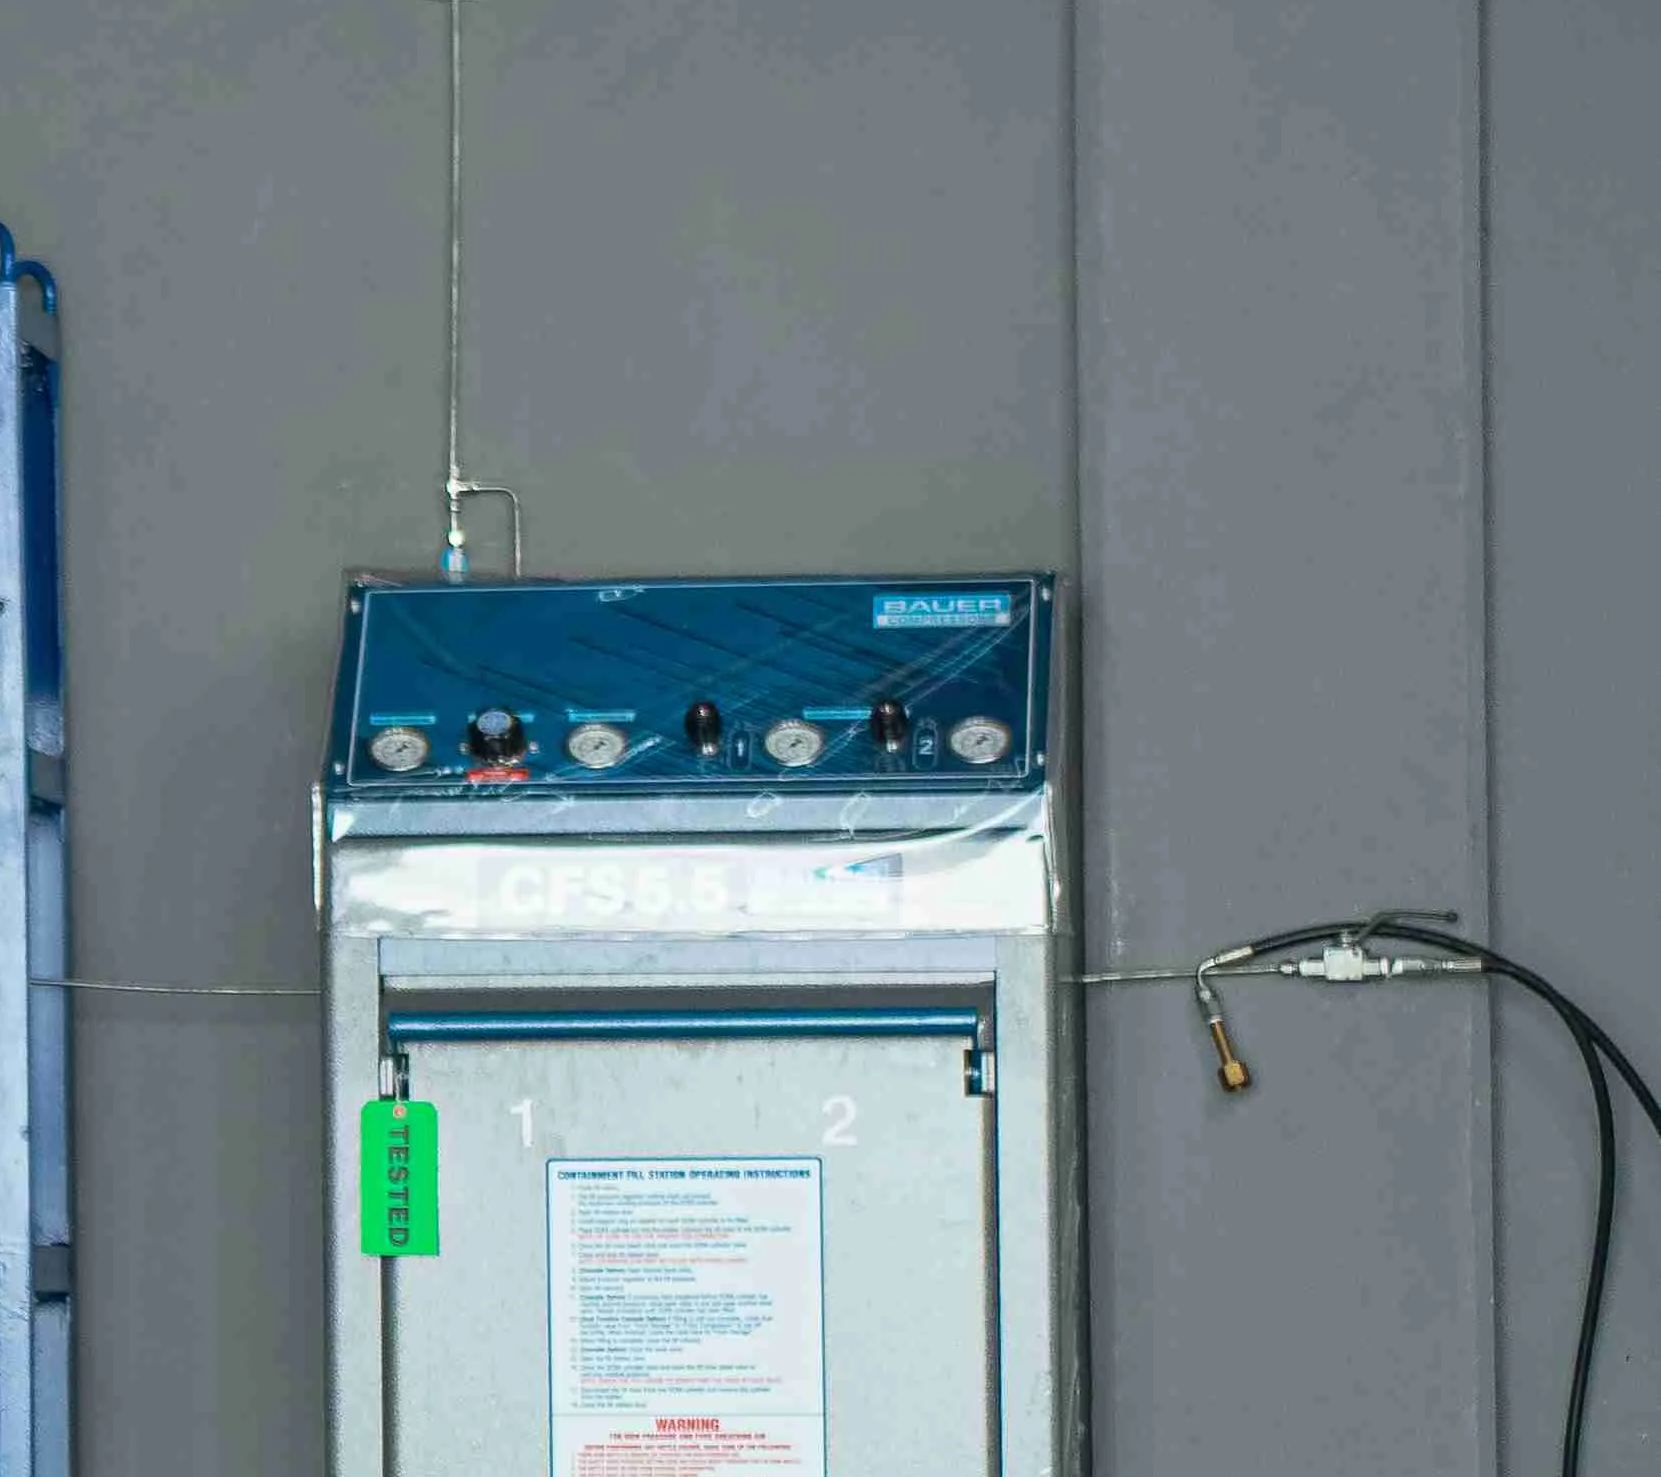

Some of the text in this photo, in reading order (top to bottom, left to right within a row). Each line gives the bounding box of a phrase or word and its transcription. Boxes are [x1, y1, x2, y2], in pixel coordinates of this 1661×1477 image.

[883, 599, 1002, 614] BAUER
[919, 739, 934, 755] 2
[510, 1098, 536, 1149] 1
[821, 1095, 859, 1147] 2
[626, 1169, 645, 1180] FILL
[647, 1169, 686, 1180] STATION
[688, 1169, 741, 1180] OPERATING
[743, 1169, 812, 1179] INSTRUCTIONS
[387, 1123, 411, 1248] TESTED
[654, 1417, 721, 1433] WARNING
